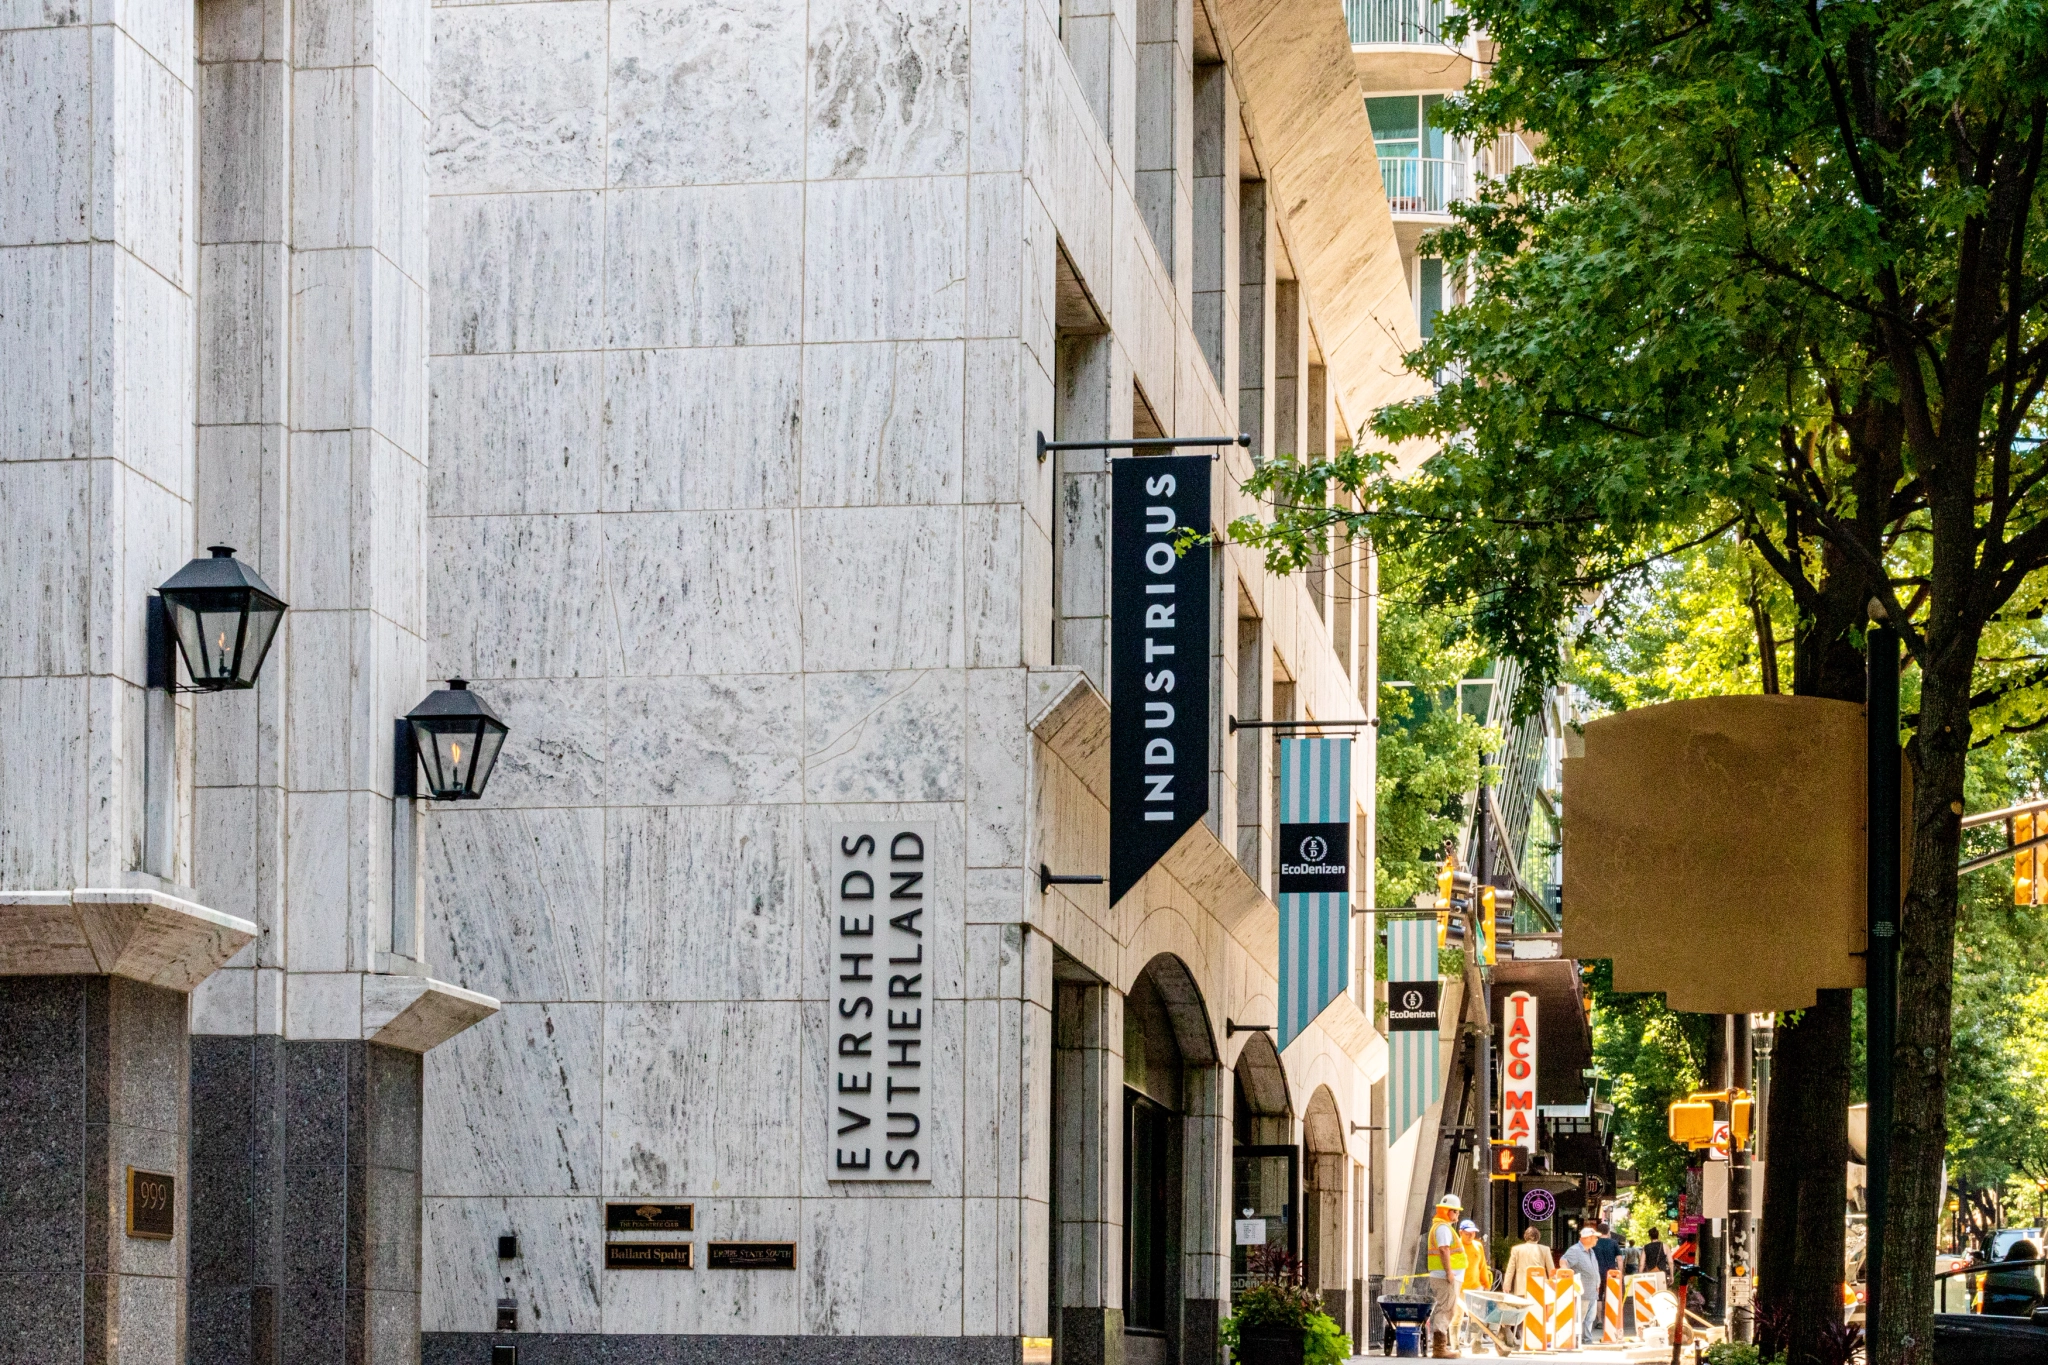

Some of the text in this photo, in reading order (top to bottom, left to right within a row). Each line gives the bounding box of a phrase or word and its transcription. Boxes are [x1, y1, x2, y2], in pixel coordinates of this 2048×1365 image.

[1144, 473, 1177, 821] INDUSTRIOUS
[1310, 840, 1318, 848] E
[1310, 849, 1318, 857] D
[1281, 862, 1346, 875] EcoDenizen
[836, 833, 876, 1170] EVERSHEDS
[885, 831, 925, 1171] SUTHERLAND
[1389, 1009, 1436, 1019] EcoDenizen
[1507, 996, 1531, 1080] TACO
[141, 1181, 166, 1210] 999
[610, 1248, 688, 1263] Ballard Spahr
[713, 1248, 792, 1258] EMPIRE STATE SOUTH
